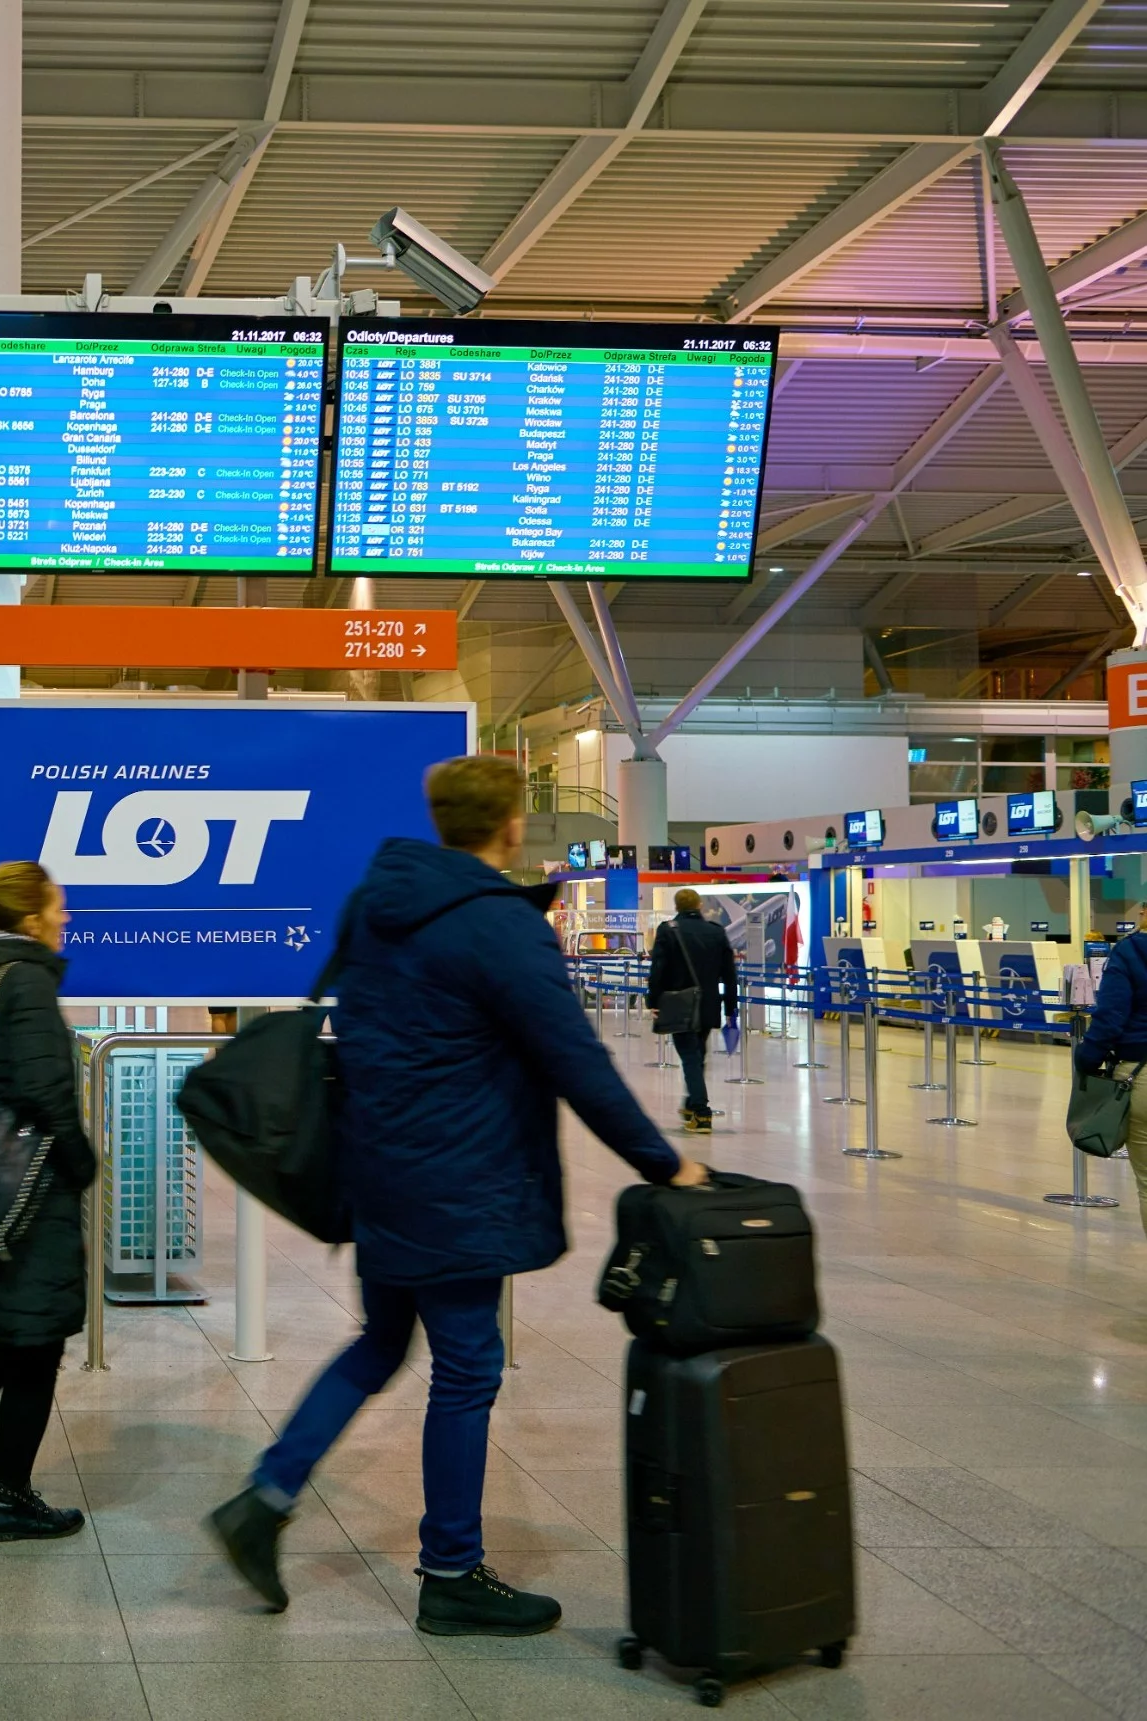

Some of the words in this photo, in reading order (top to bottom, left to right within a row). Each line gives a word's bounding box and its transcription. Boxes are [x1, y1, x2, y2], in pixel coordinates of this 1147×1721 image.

[232, 330, 286, 341] 21.11.2017
[293, 332, 322, 342] 06:32
[345, 330, 454, 344] Odloty/Departures
[683, 340, 736, 349] 21.11.2017
[743, 341, 771, 350] 06:32
[346, 347, 368, 355] Czas
[396, 347, 416, 358] Rejs
[450, 348, 500, 357] Codeshare
[531, 350, 571, 359] Do/Przez
[604, 352, 645, 362] Odprawa
[649, 352, 676, 361] Strefa
[687, 353, 716, 364] Uwagi
[730, 354, 765, 364] Pogoda
[73, 366, 114, 377] Hamburg
[528, 363, 567, 371] Katowice
[530, 374, 563, 382] Gdańsk
[527, 385, 564, 393] Charków
[529, 396, 561, 404] Kraków
[343, 426, 365, 434] 10:50
[398, 427, 410, 435] LO
[416, 427, 432, 435] 535
[520, 429, 565, 439] Budapeszt
[600, 431, 634, 439] 241-280
[526, 440, 557, 450] Madryt
[528, 452, 553, 462] Praga
[72, 466, 110, 475] Frankfurt
[513, 462, 529, 470] Los
[531, 463, 566, 472] Angeles
[526, 484, 549, 494] Ryga
[513, 496, 560, 505] Kaliningrad
[72, 510, 107, 519] Moskwa
[525, 506, 547, 514] Sofia
[519, 517, 551, 525] Odessa
[506, 527, 543, 538] Montego
[545, 528, 563, 537] Bay
[513, 538, 555, 546] Bukareszt
[345, 621, 403, 636] 251-270
[346, 643, 403, 657] 271-280
[31, 765, 107, 779] POLISH
[114, 765, 210, 779] AIRLINES
[1010, 804, 1033, 819] LOT
[938, 812, 957, 825] LOT
[849, 821, 865, 834] LOT
[38, 790, 310, 885] LOT
[59, 931, 94, 944] TAR
[101, 931, 191, 943] ALLIANCE
[197, 931, 276, 942] MEMBER
